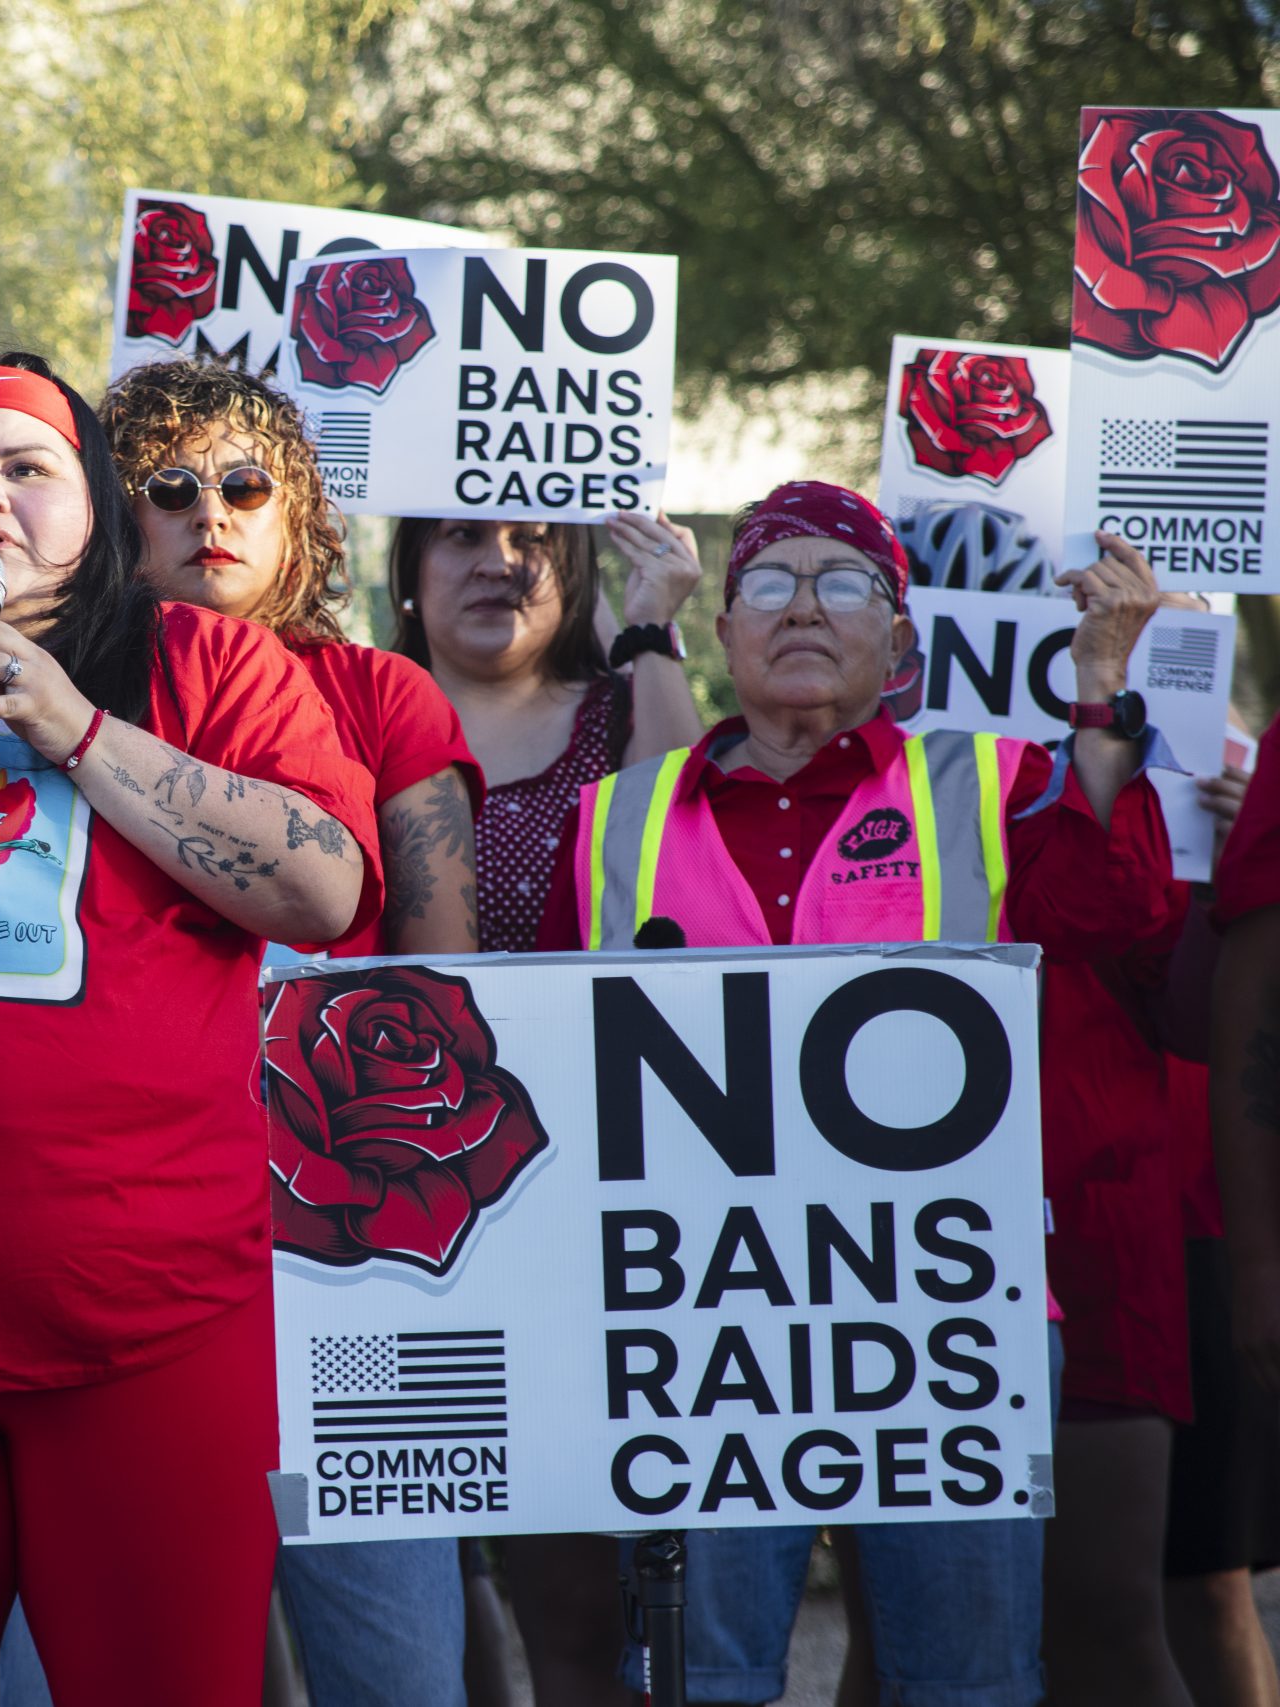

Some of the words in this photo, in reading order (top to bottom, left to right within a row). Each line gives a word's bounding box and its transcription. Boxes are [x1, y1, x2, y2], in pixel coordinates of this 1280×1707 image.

[460, 256, 655, 355] NO
[458, 364, 654, 419] BANS.
[455, 419, 653, 468] RAIDS.
[318, 466, 368, 481] MON
[454, 468, 652, 512] CAGES.
[1099, 515, 1263, 544] COMMON
[1098, 545, 1262, 575] FENSE
[1146, 676, 1214, 694] DEFENSE
[1147, 664, 1215, 680] COMMON
[831, 860, 920, 885] SAFETY
[15, 922, 58, 944] OUT
[592, 966, 1013, 1182] NO
[601, 1197, 1023, 1313] BANS.
[606, 1317, 1026, 1421] RAIDS.
[315, 1446, 508, 1482] COMMON
[610, 1426, 1031, 1516] CAGES.
[317, 1481, 510, 1518] DEFENSE
